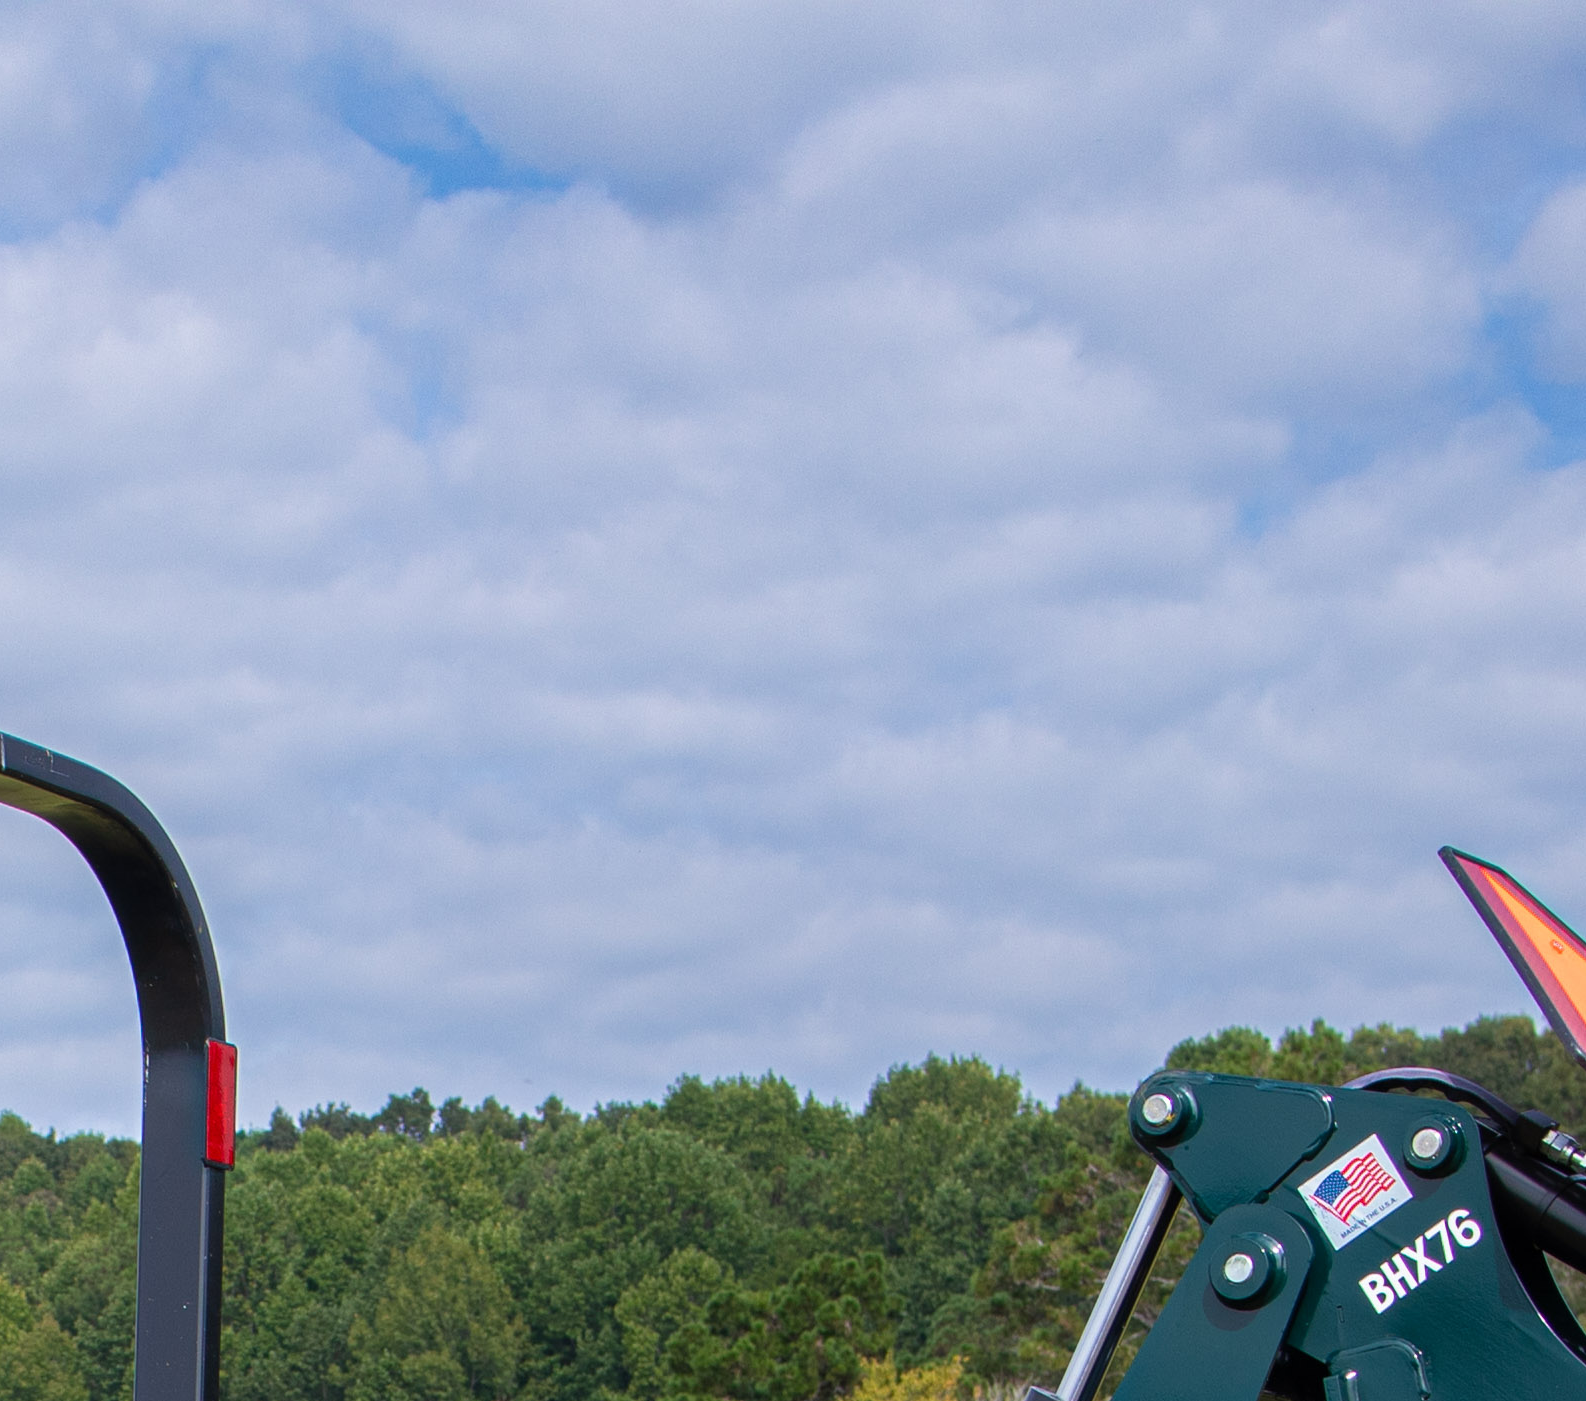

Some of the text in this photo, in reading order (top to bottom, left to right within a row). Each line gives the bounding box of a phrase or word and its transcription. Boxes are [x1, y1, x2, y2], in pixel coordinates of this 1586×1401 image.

[1340, 1221, 1361, 1239] MADE
[1366, 1208, 1380, 1222] THE
[1358, 1209, 1481, 1314] BHX76
